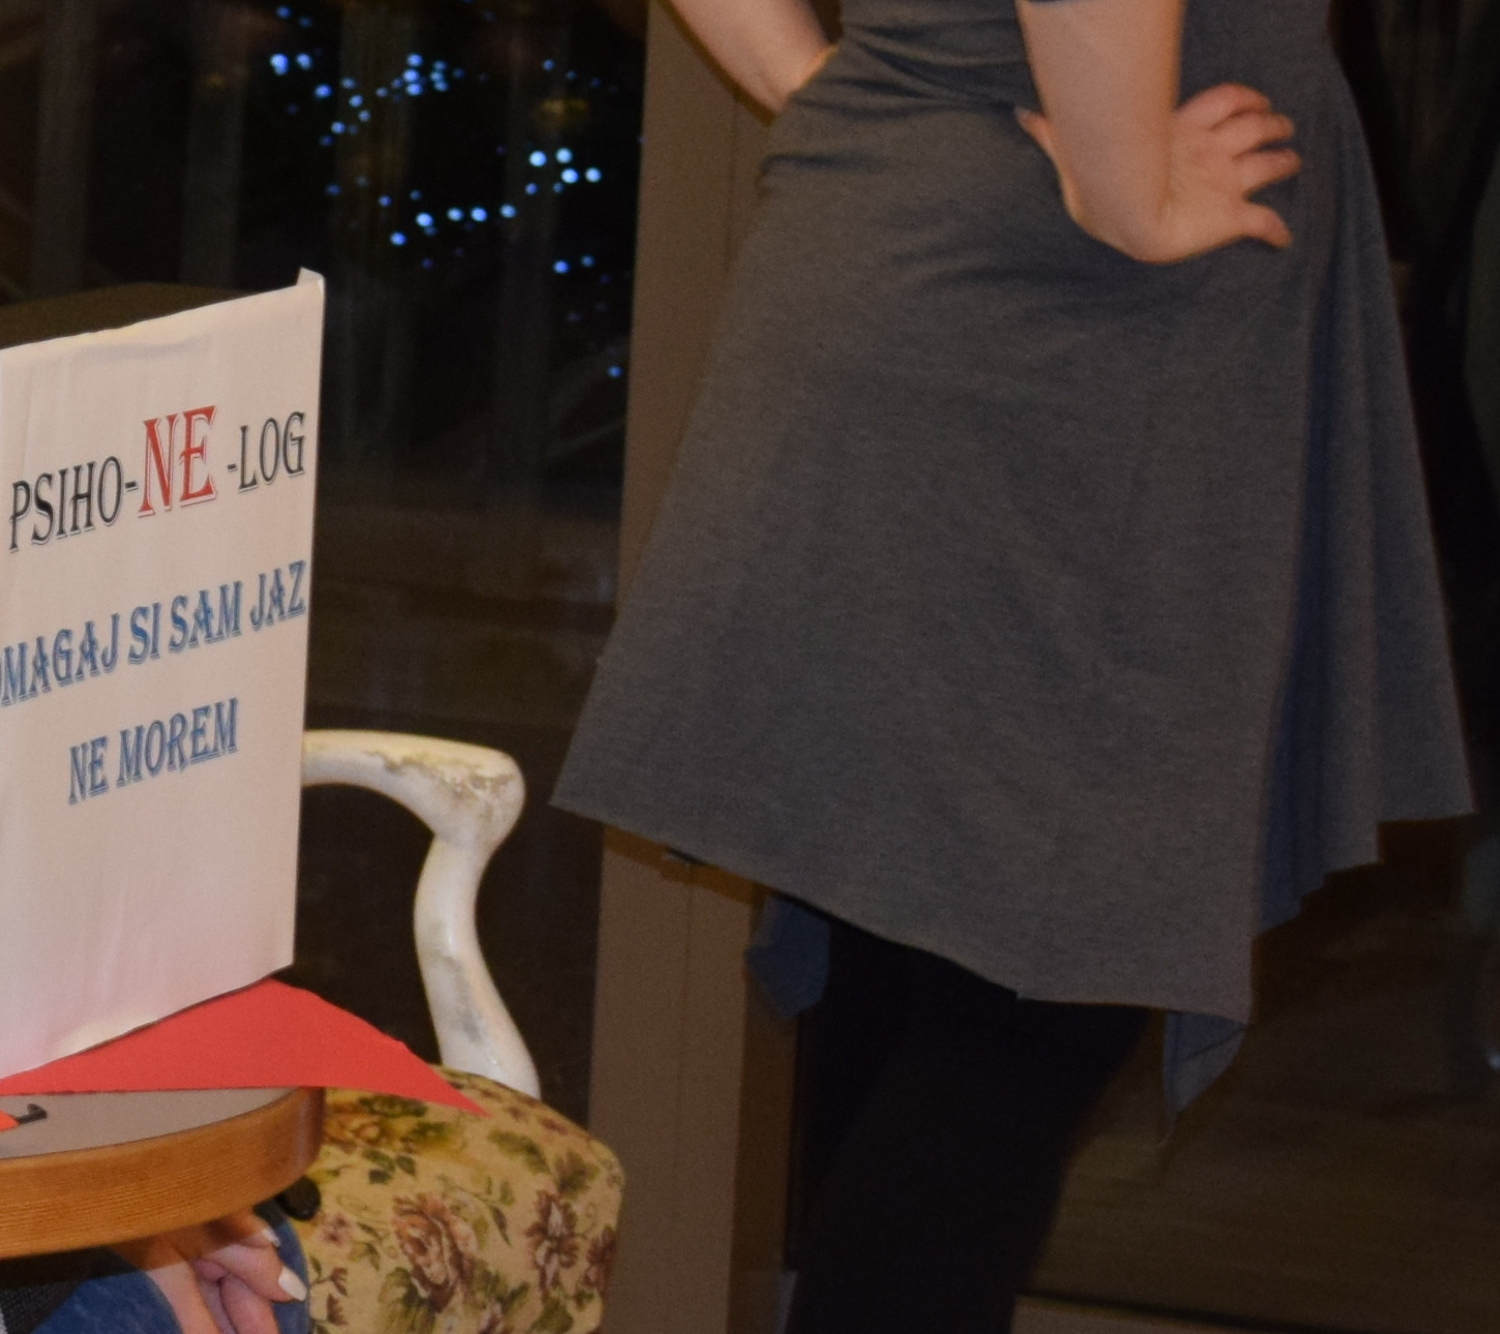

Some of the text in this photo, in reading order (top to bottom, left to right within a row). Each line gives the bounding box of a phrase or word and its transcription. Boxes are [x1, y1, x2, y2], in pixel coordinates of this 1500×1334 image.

[127, 602, 162, 665] SI
[168, 580, 243, 652] SAM
[250, 559, 307, 631] JAZ
[68, 697, 239, 806] NE MOREM
